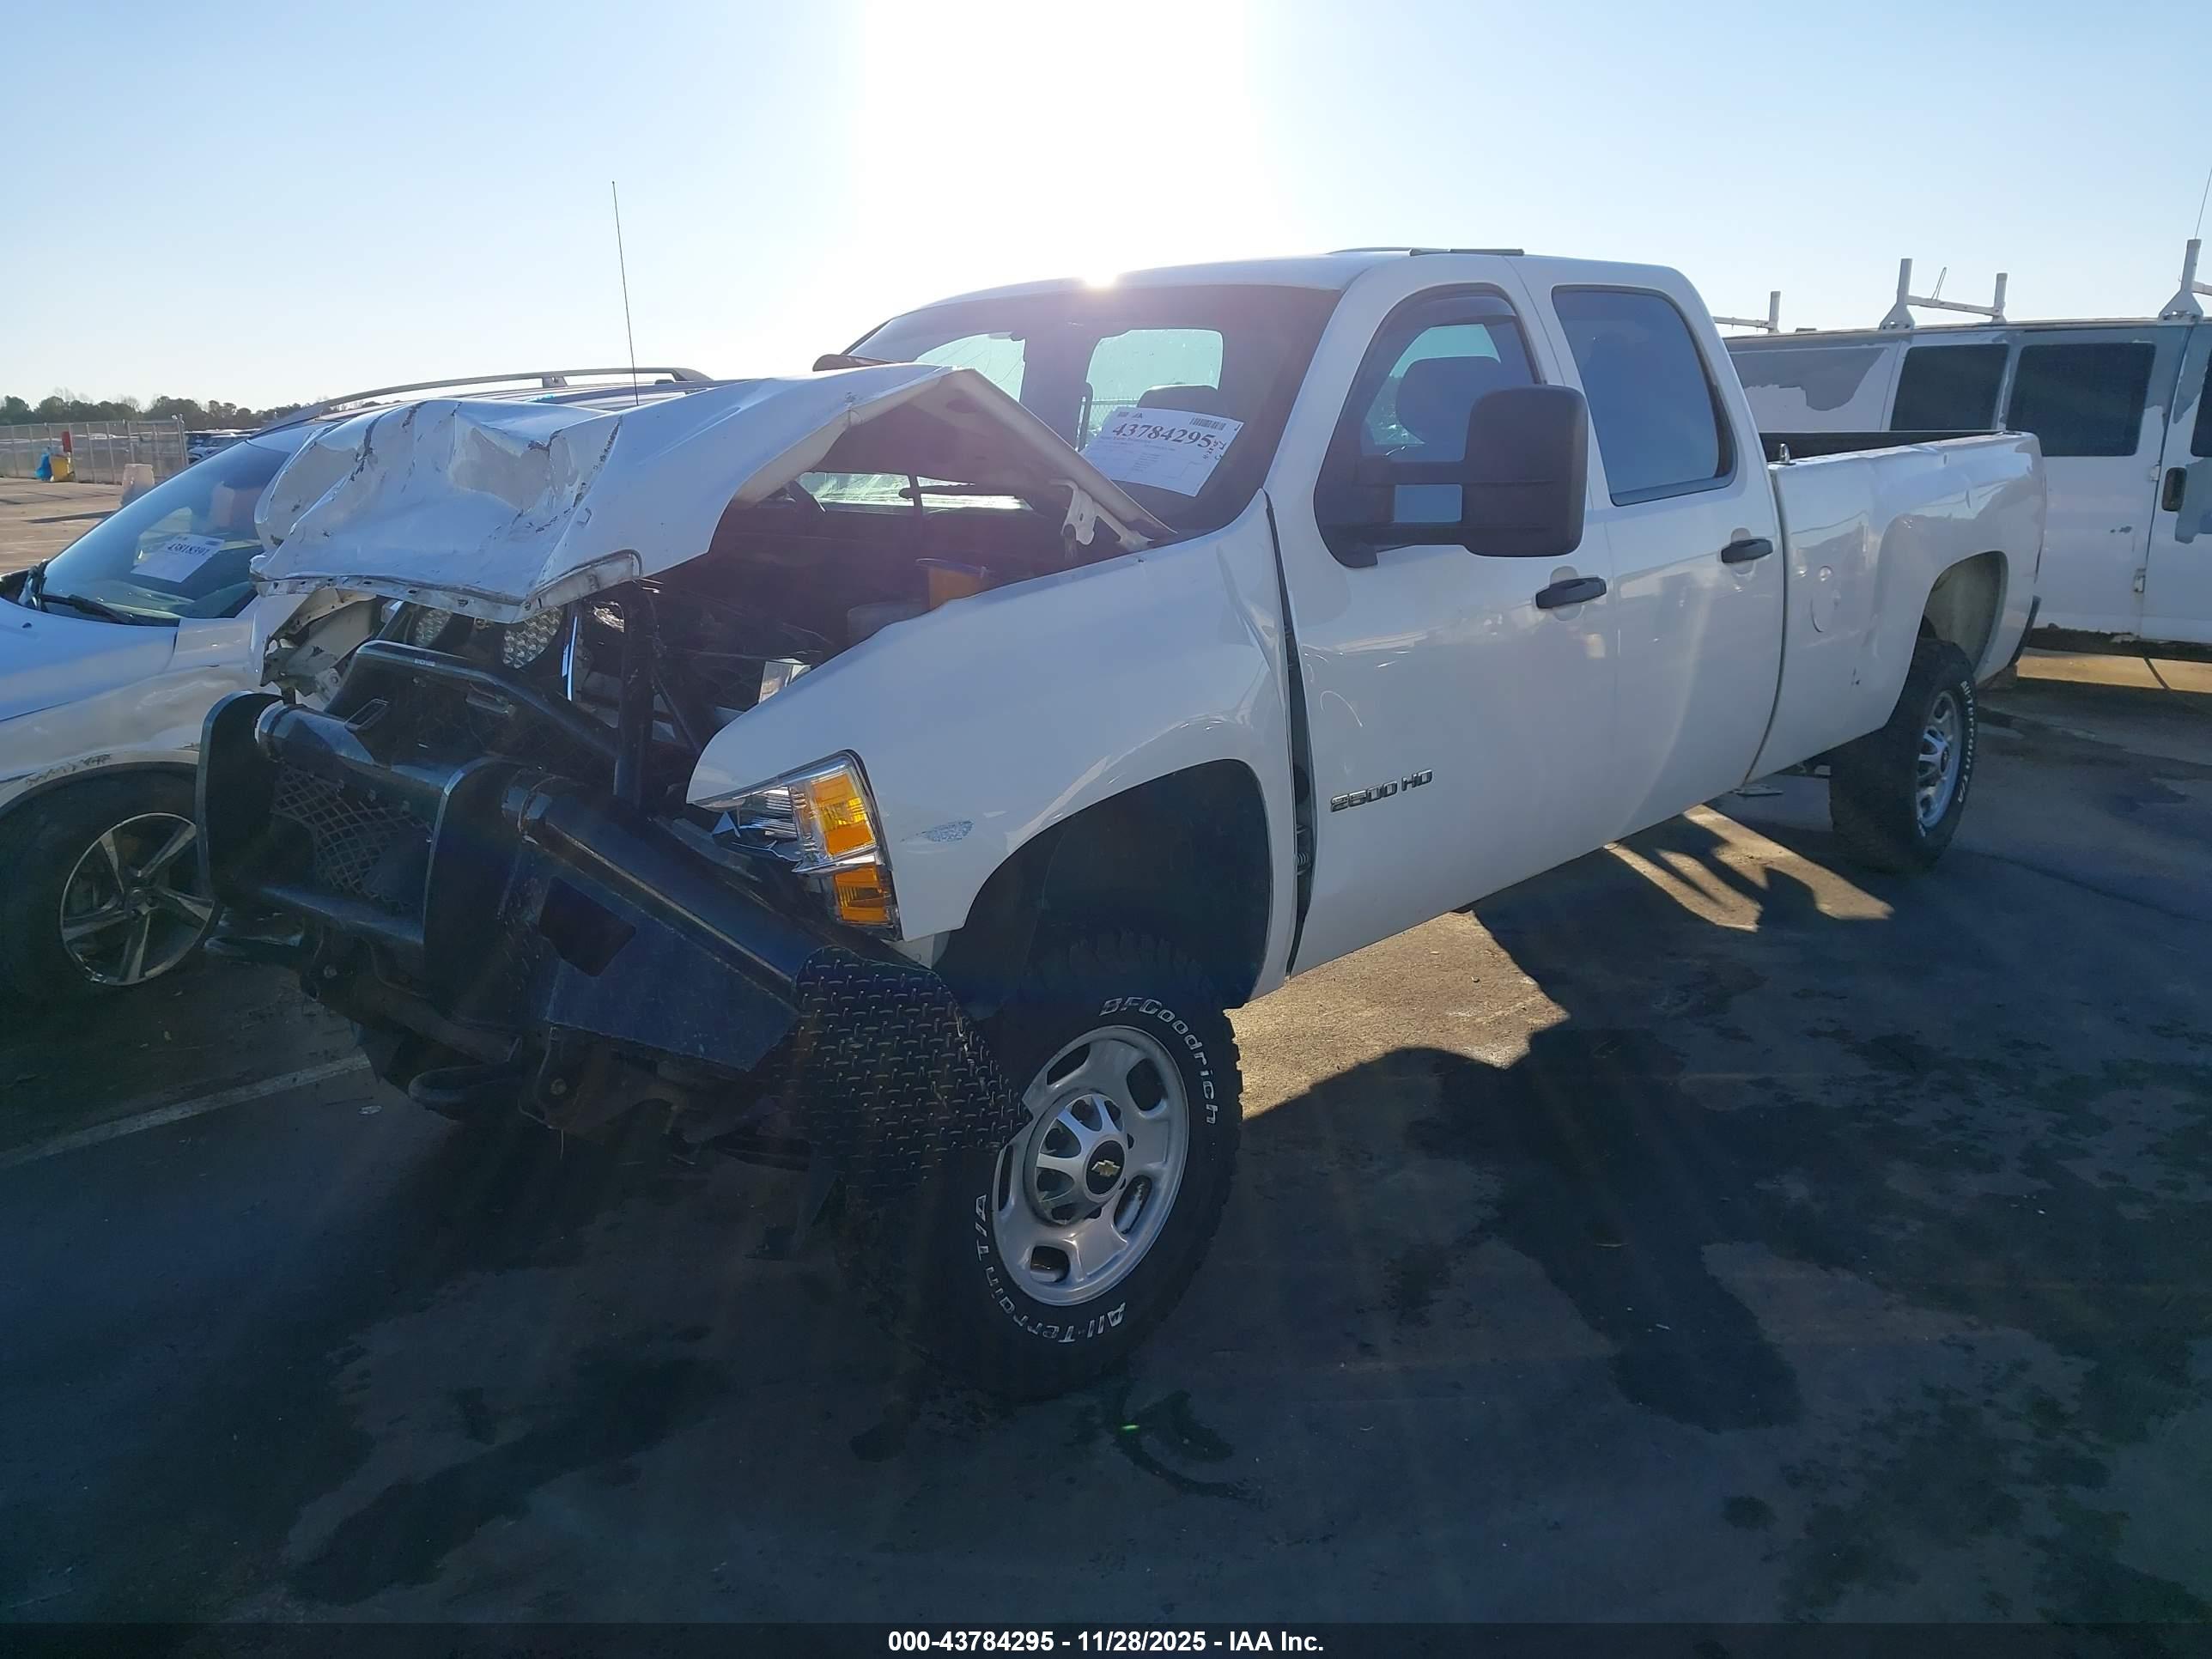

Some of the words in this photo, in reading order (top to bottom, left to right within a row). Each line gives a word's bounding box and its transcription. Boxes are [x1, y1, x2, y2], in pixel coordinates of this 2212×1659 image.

[1113, 423, 1216, 447] 43784295
[1330, 780, 1398, 812] 2500
[1401, 769, 1433, 792] HD
[1098, 996, 1218, 1125] BFGoodrich
[975, 1194, 990, 1261] T/A
